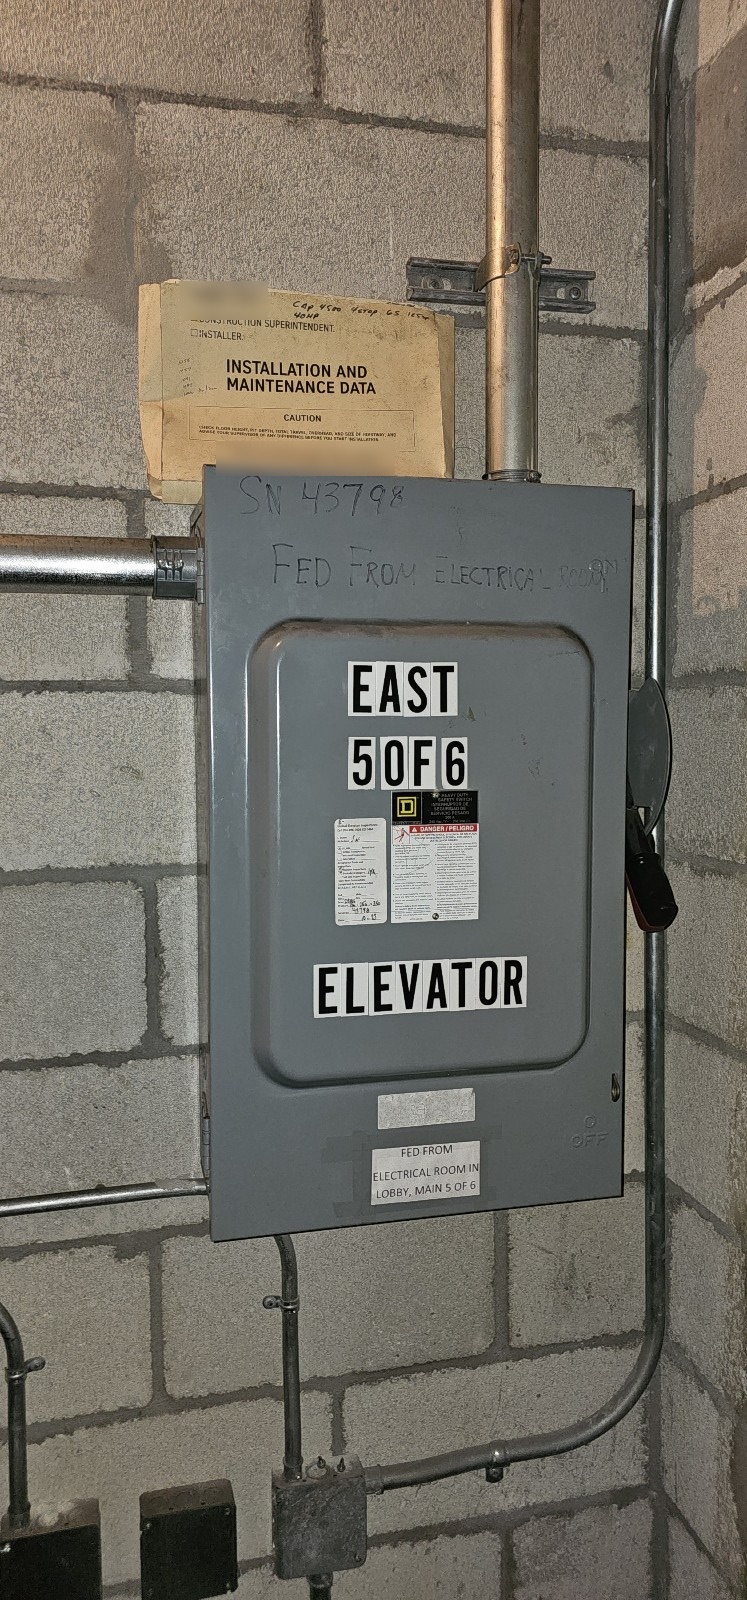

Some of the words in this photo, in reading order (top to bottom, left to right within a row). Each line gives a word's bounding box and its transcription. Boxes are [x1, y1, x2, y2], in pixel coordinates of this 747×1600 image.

[226, 358, 331, 378] INSTALLATION
[336, 364, 368, 379] AND
[226, 377, 335, 394] MAINTENANCE
[340, 381, 377, 395] DATA
[283, 414, 322, 422] CAUTION
[239, 475, 282, 516] SN
[301, 481, 405, 517] 43798
[271, 542, 332, 588] FED
[348, 544, 417, 589] FROM
[352, 664, 455, 714] EAST
[352, 739, 373, 786] 5
[384, 739, 433, 787] OF
[446, 740, 465, 787] 6
[318, 959, 523, 1015] ELEVATOR
[401, 1147, 420, 1158] FED
[422, 1144, 453, 1156] FROM
[373, 1168, 431, 1182] ELECTRICAL
[434, 1164, 466, 1176] ROOM
[469, 1163, 479, 1172] IN
[376, 1187, 412, 1199] LOBBY,
[415, 1183, 442, 1196] MAIN
[445, 1183, 452, 1192] 5
[454, 1181, 467, 1191] OF
[470, 1180, 476, 1190] 6
